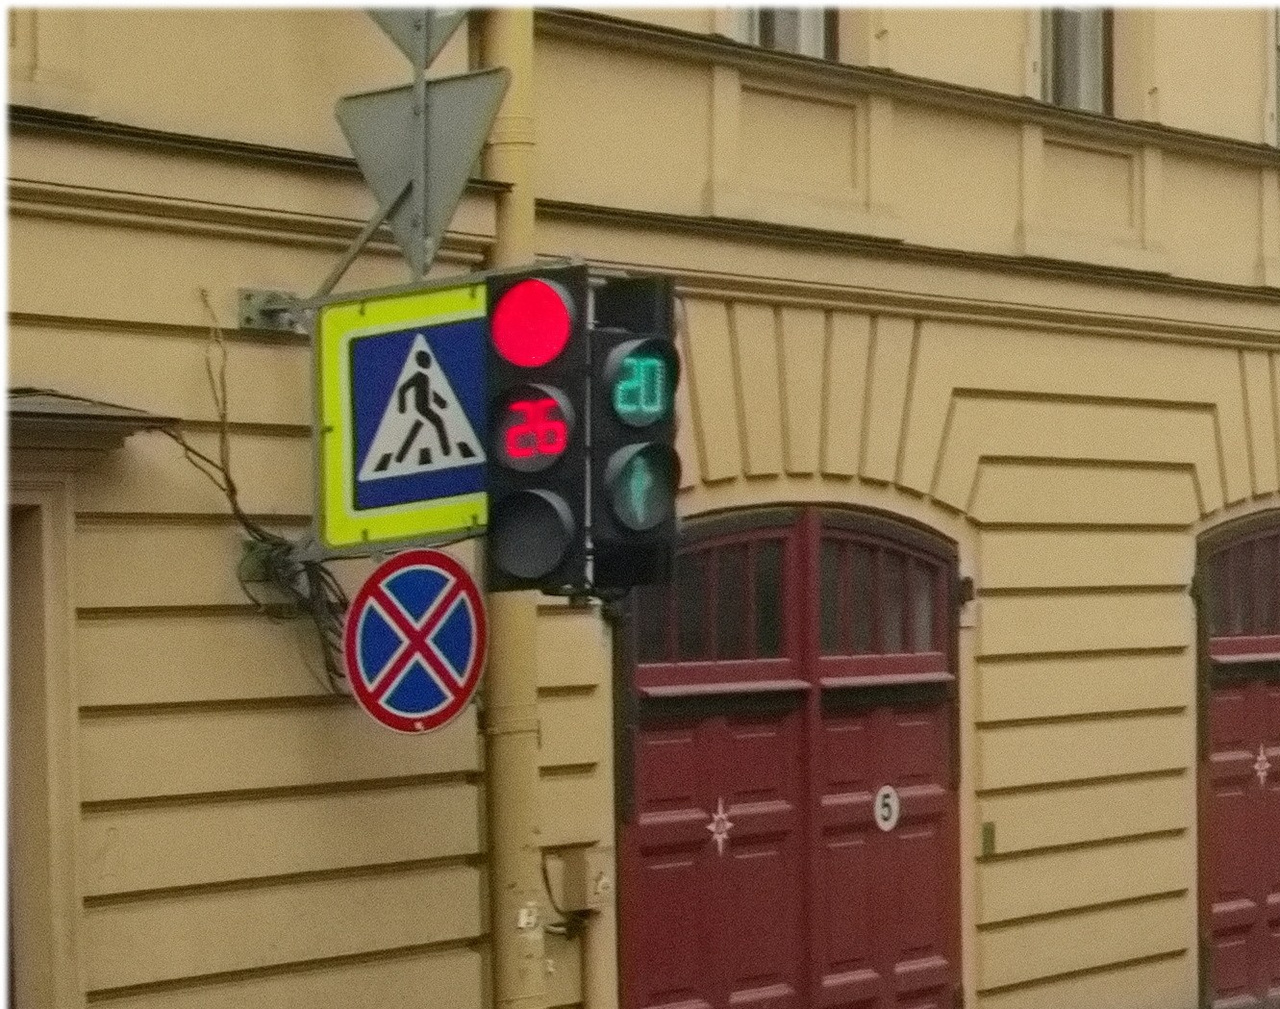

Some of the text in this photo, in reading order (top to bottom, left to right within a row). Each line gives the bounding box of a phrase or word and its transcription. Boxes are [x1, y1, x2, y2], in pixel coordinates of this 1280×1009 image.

[617, 356, 663, 413] 20
[506, 397, 568, 458] 26
[880, 792, 893, 822] 5
